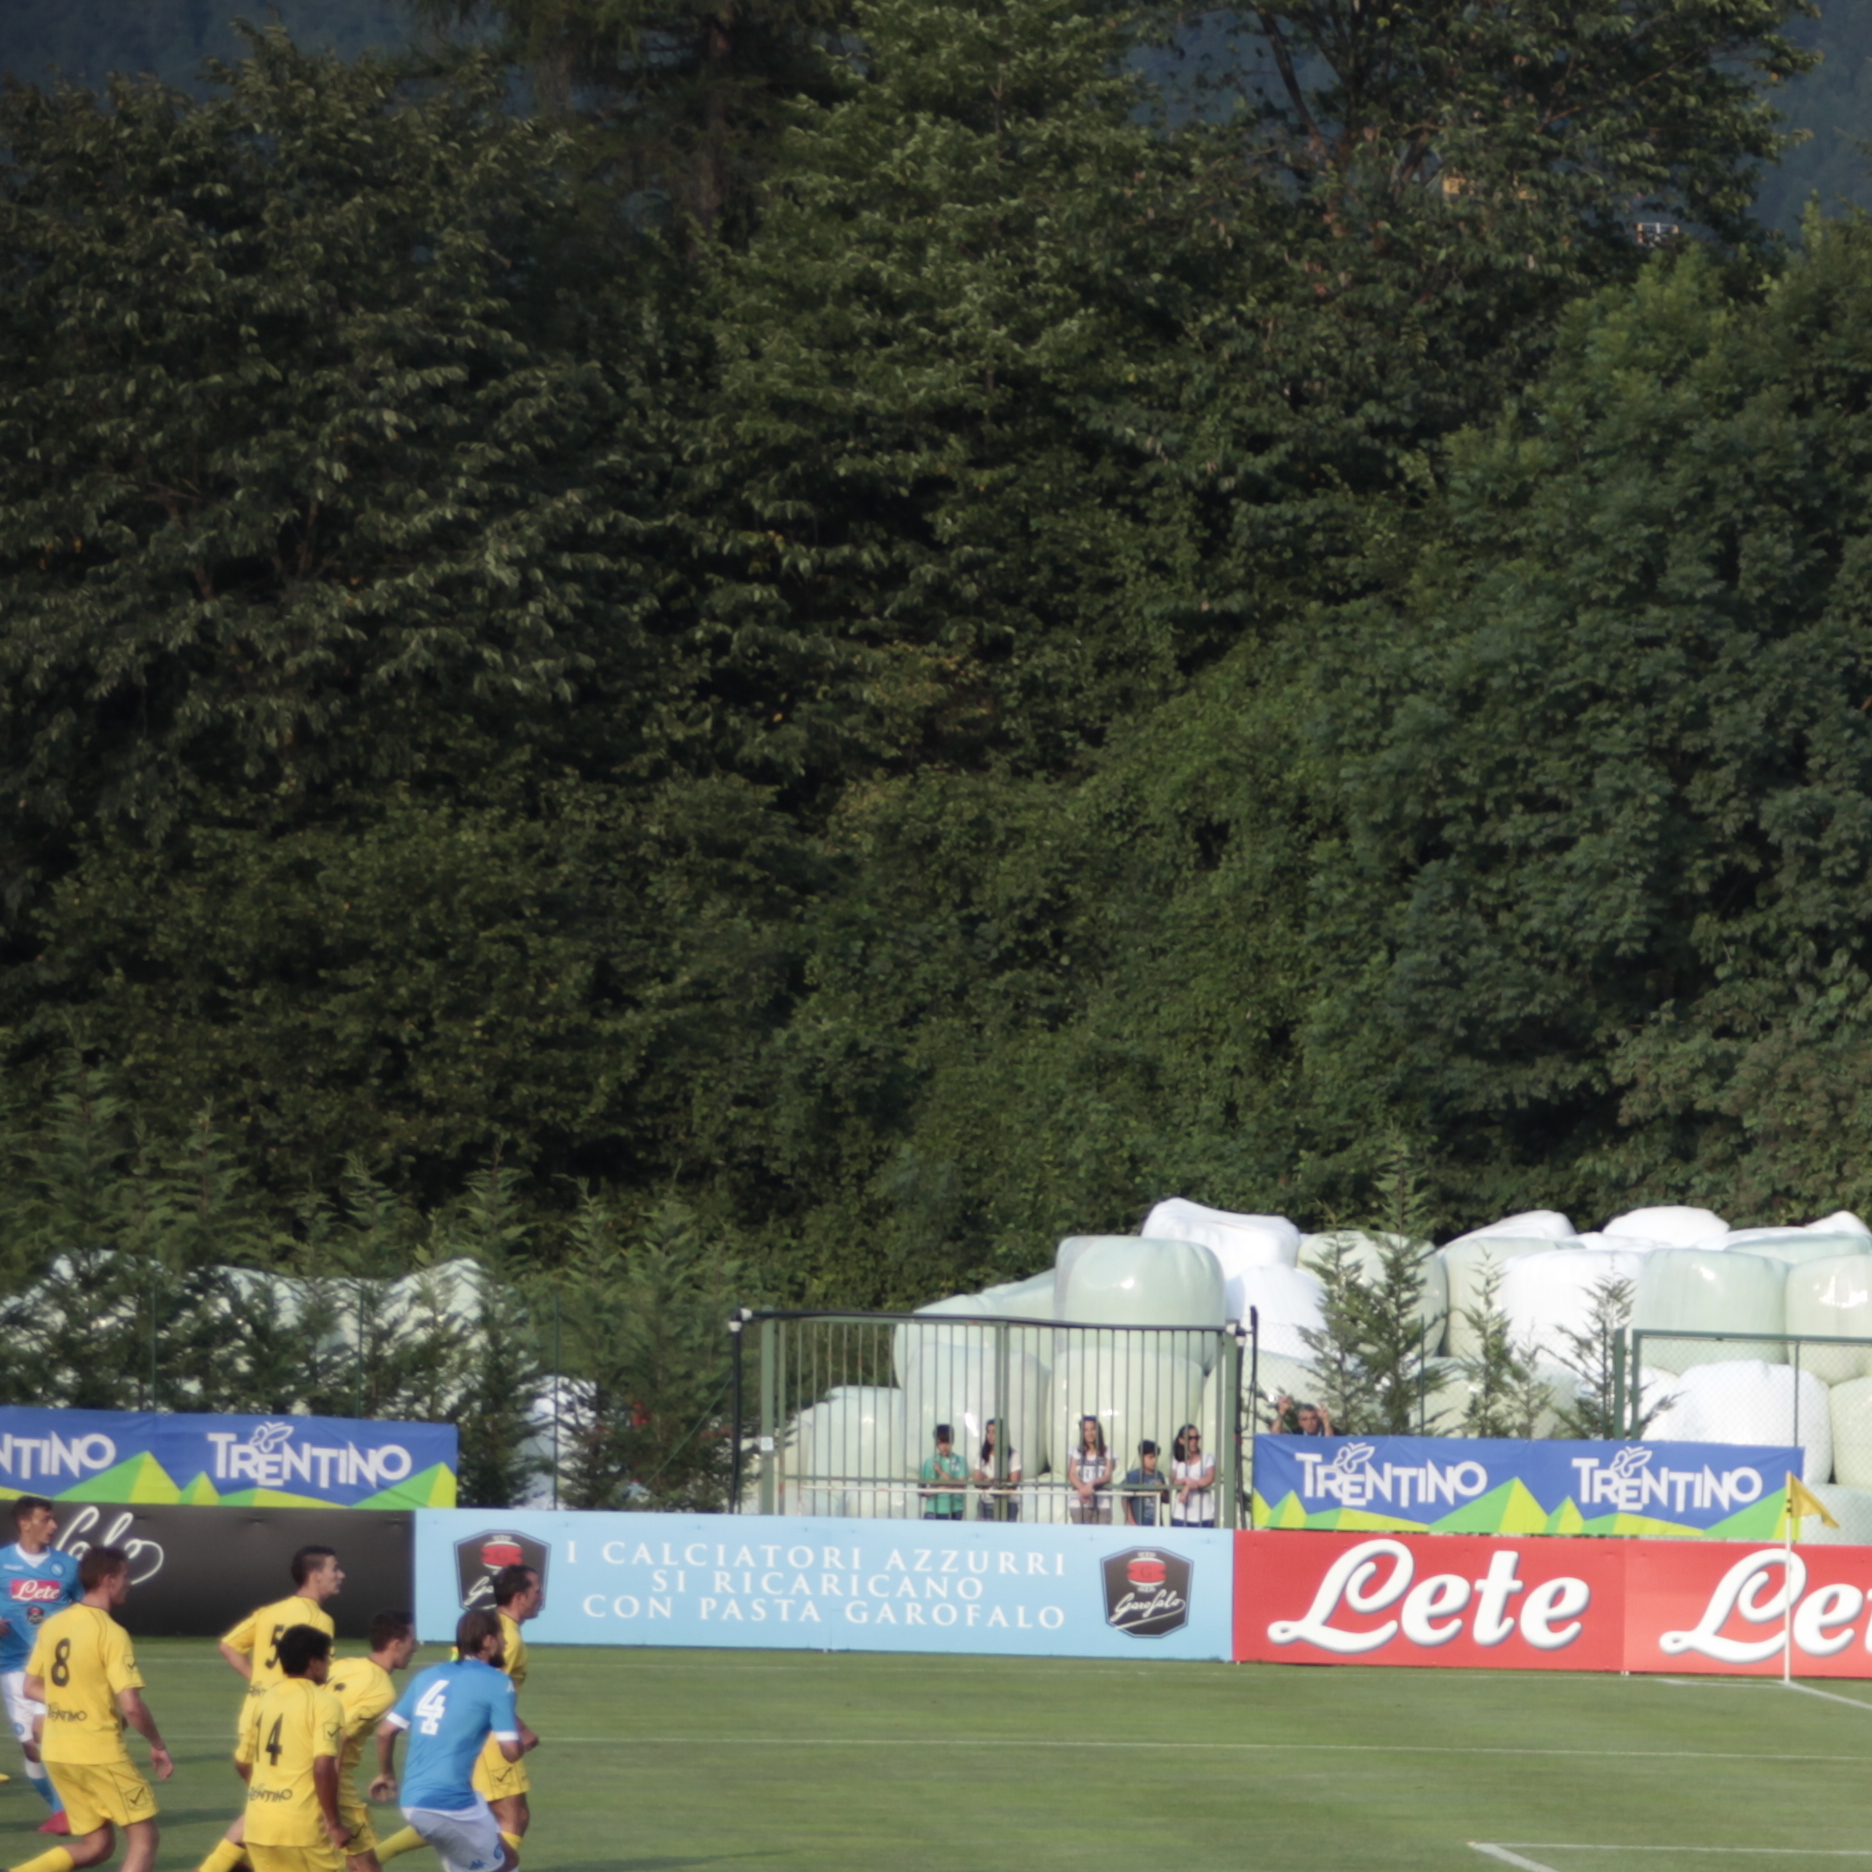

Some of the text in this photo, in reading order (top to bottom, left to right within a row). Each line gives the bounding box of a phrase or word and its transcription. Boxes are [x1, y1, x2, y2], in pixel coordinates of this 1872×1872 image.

[207, 1432, 412, 1488] TRENTINO
[1295, 1452, 1488, 1507] TRENTINO
[1572, 1457, 1763, 1513] TRENTINO
[566, 1540, 1066, 1576] I CALCIATORI AZZURRI
[12, 1580, 60, 1601] Lete
[652, 1570, 984, 1600] SI RICARICANO
[1110, 1589, 1186, 1629] Garofalo
[1267, 1538, 1591, 1655] Lete
[582, 1594, 1065, 1629] CON PASTA GAROFALO
[51, 1637, 71, 1687] 8
[415, 1679, 450, 1735] 4
[255, 1712, 284, 1767] 14
